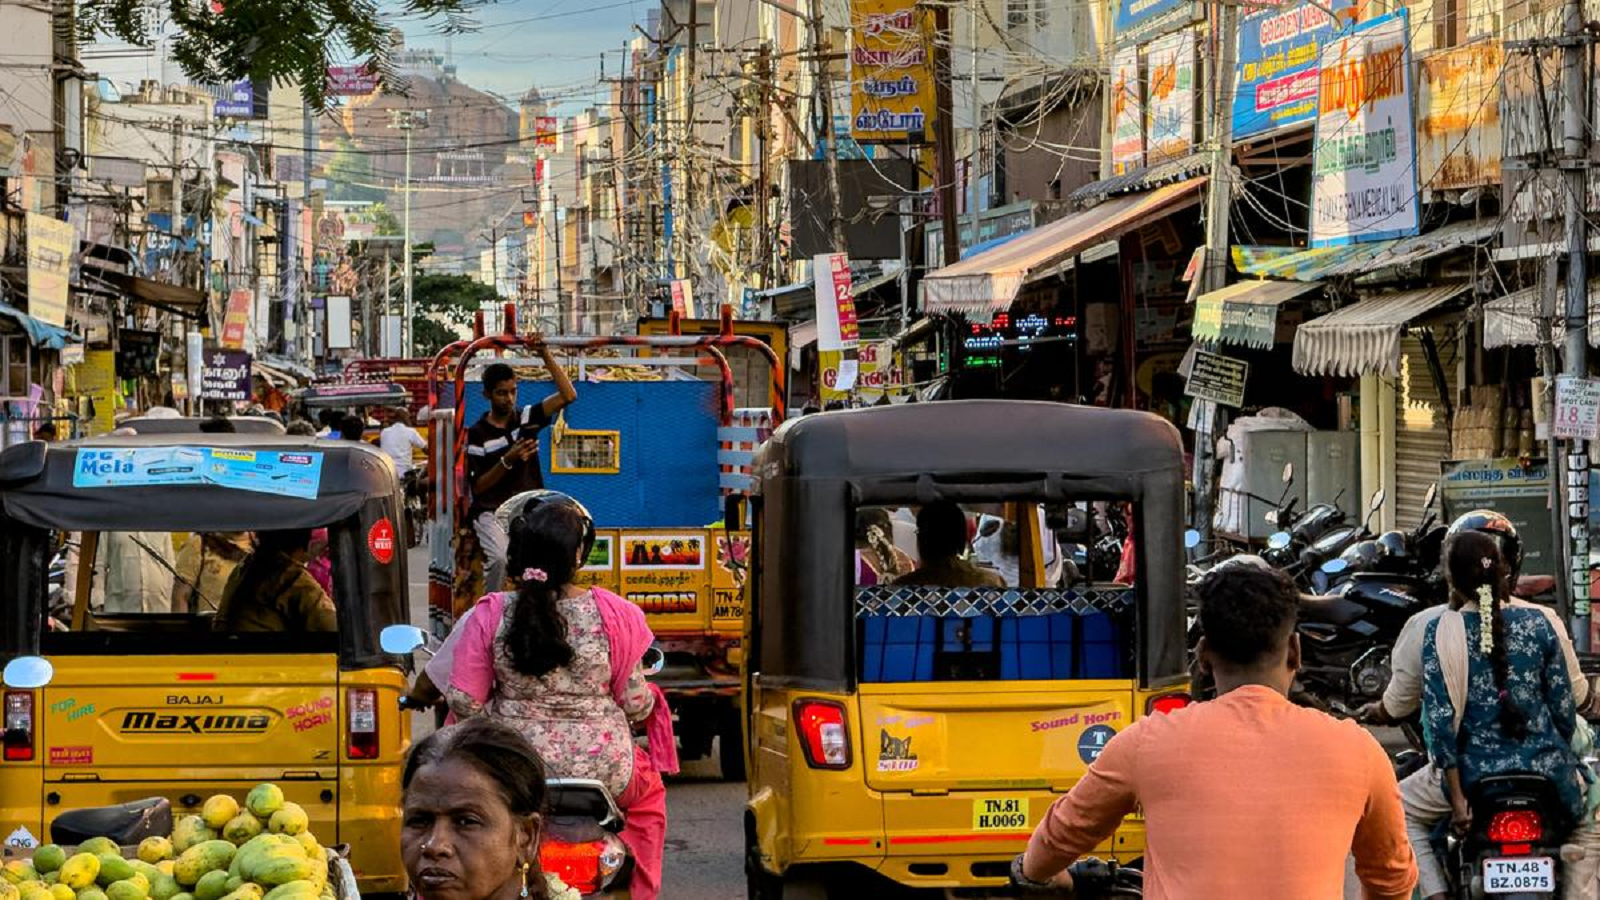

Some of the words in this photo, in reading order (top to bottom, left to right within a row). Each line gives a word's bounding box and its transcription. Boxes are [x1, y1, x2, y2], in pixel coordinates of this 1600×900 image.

[1260, 9, 1299, 45] GOLDEN
[81, 459, 134, 476] Mela
[626, 592, 697, 613] HORN
[716, 592, 733, 602] TN
[714, 606, 729, 618] AM
[166, 695, 224, 705] BAJAJ
[286, 696, 334, 720] SOUND
[119, 711, 271, 734] Maxima
[292, 712, 334, 733] HORN
[1031, 713, 1079, 732] Sound
[1084, 711, 1121, 725] Horn
[1093, 731, 1107, 745] T
[313, 750, 331, 760] Z
[985, 800, 1020, 812] TN.81
[979, 814, 1025, 828] H.0069
[10, 838, 32, 847] CNG
[1496, 862, 1540, 874] TN.48
[1490, 876, 1549, 889] BZ.0875
